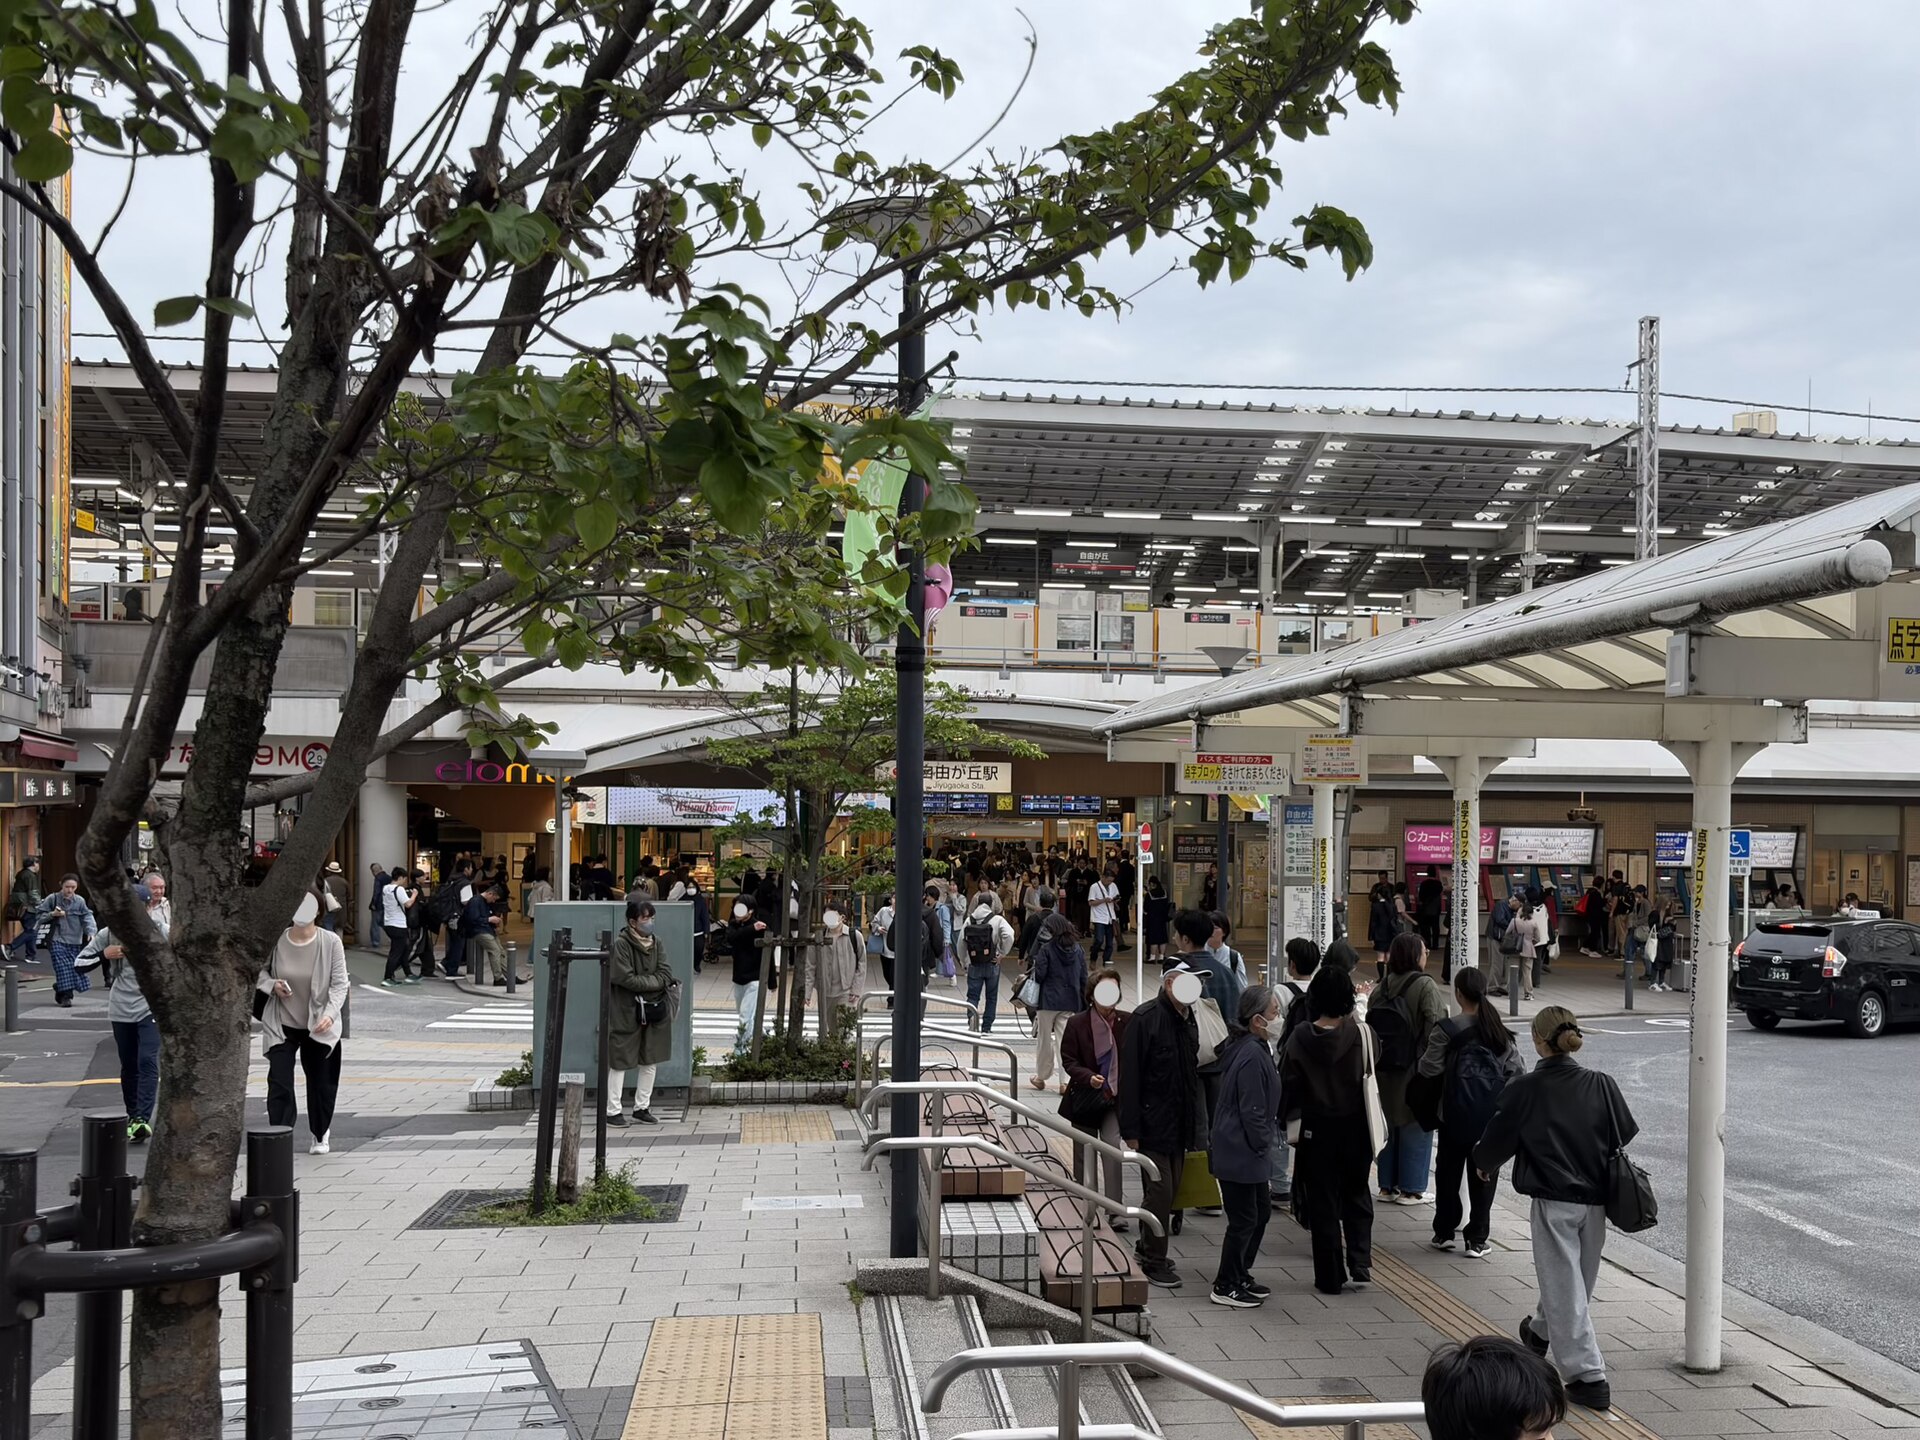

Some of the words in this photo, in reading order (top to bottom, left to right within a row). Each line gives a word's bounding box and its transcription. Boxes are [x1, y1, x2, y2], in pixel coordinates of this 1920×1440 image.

[1080, 552, 1109, 560] 自由が丘
[1200, 756, 1269, 764] バスをご利用の方へ
[435, 760, 571, 783] etom
[923, 765, 999, 780] 自由が丘駅
[1184, 765, 1289, 780] 点字ブロックをさけておまちください
